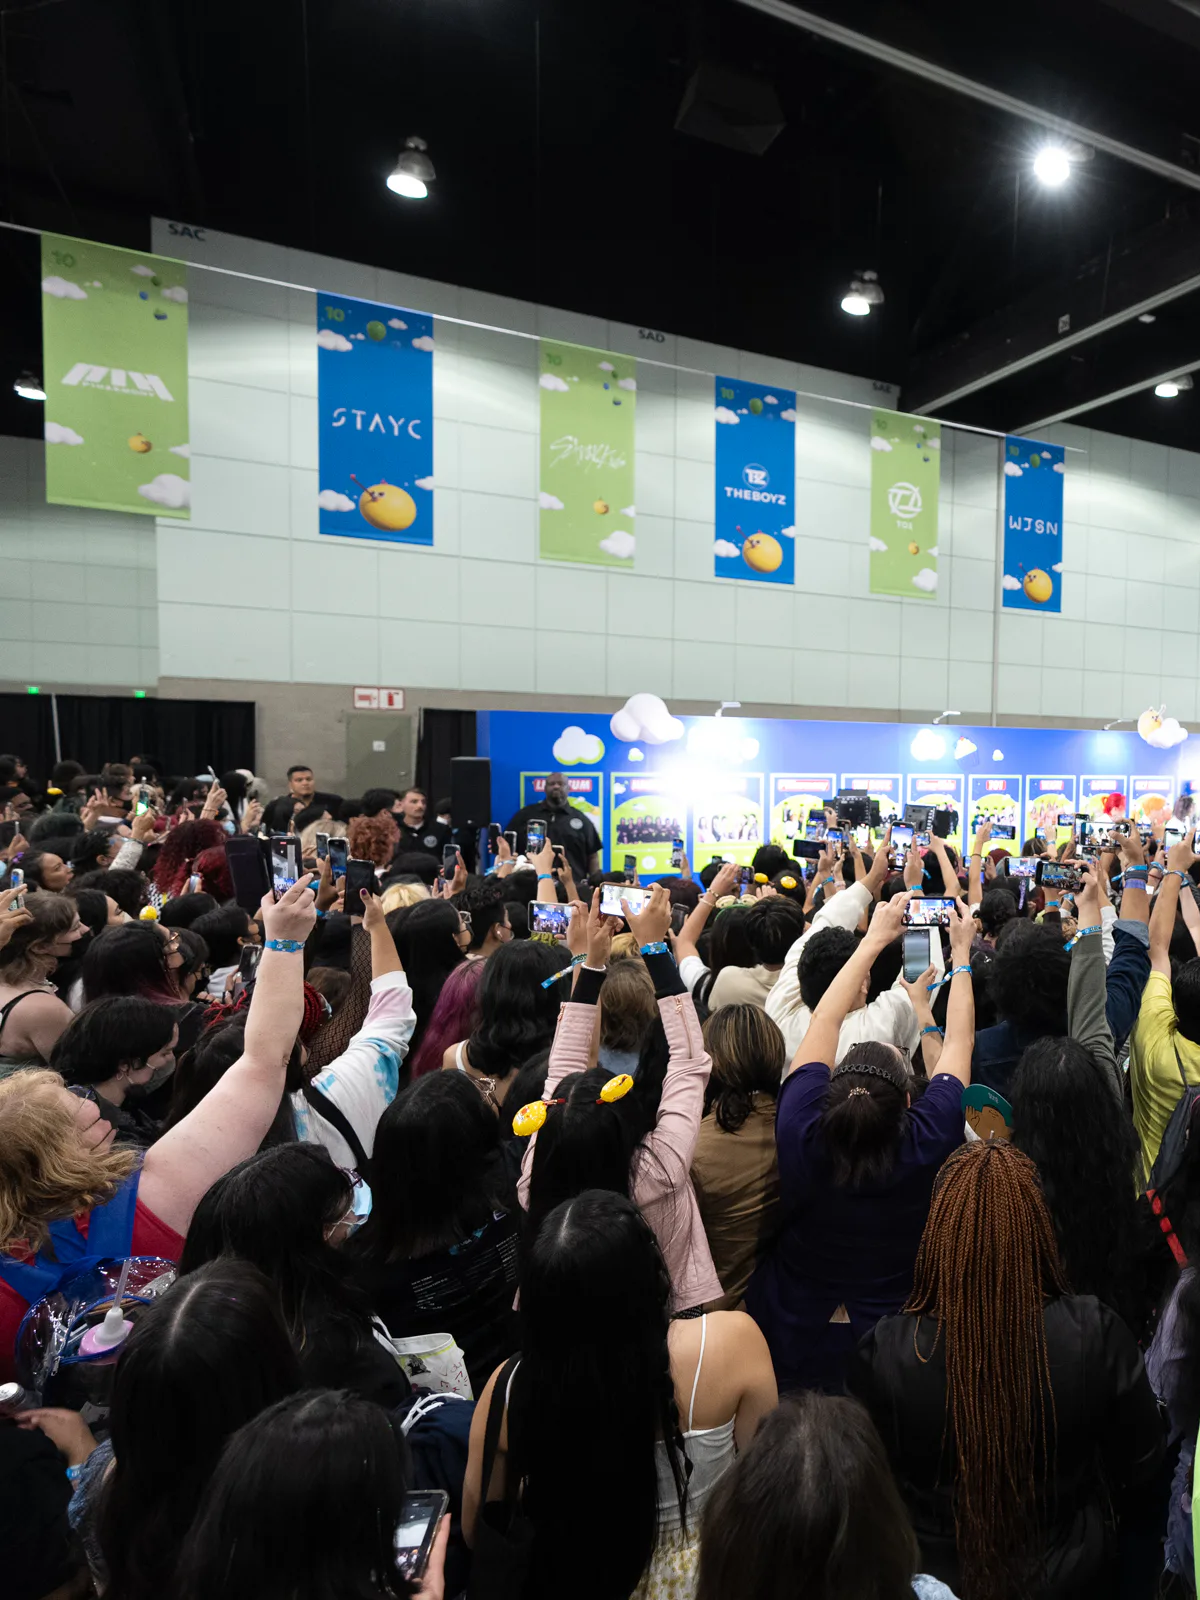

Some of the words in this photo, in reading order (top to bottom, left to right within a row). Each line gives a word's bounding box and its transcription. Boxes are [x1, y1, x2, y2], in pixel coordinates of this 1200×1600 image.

[167, 223, 206, 242] SAC
[325, 306, 345, 322] 10
[638, 329, 665, 343] SAD
[332, 408, 421, 440] STAYC
[1009, 515, 1058, 536] WJSN
